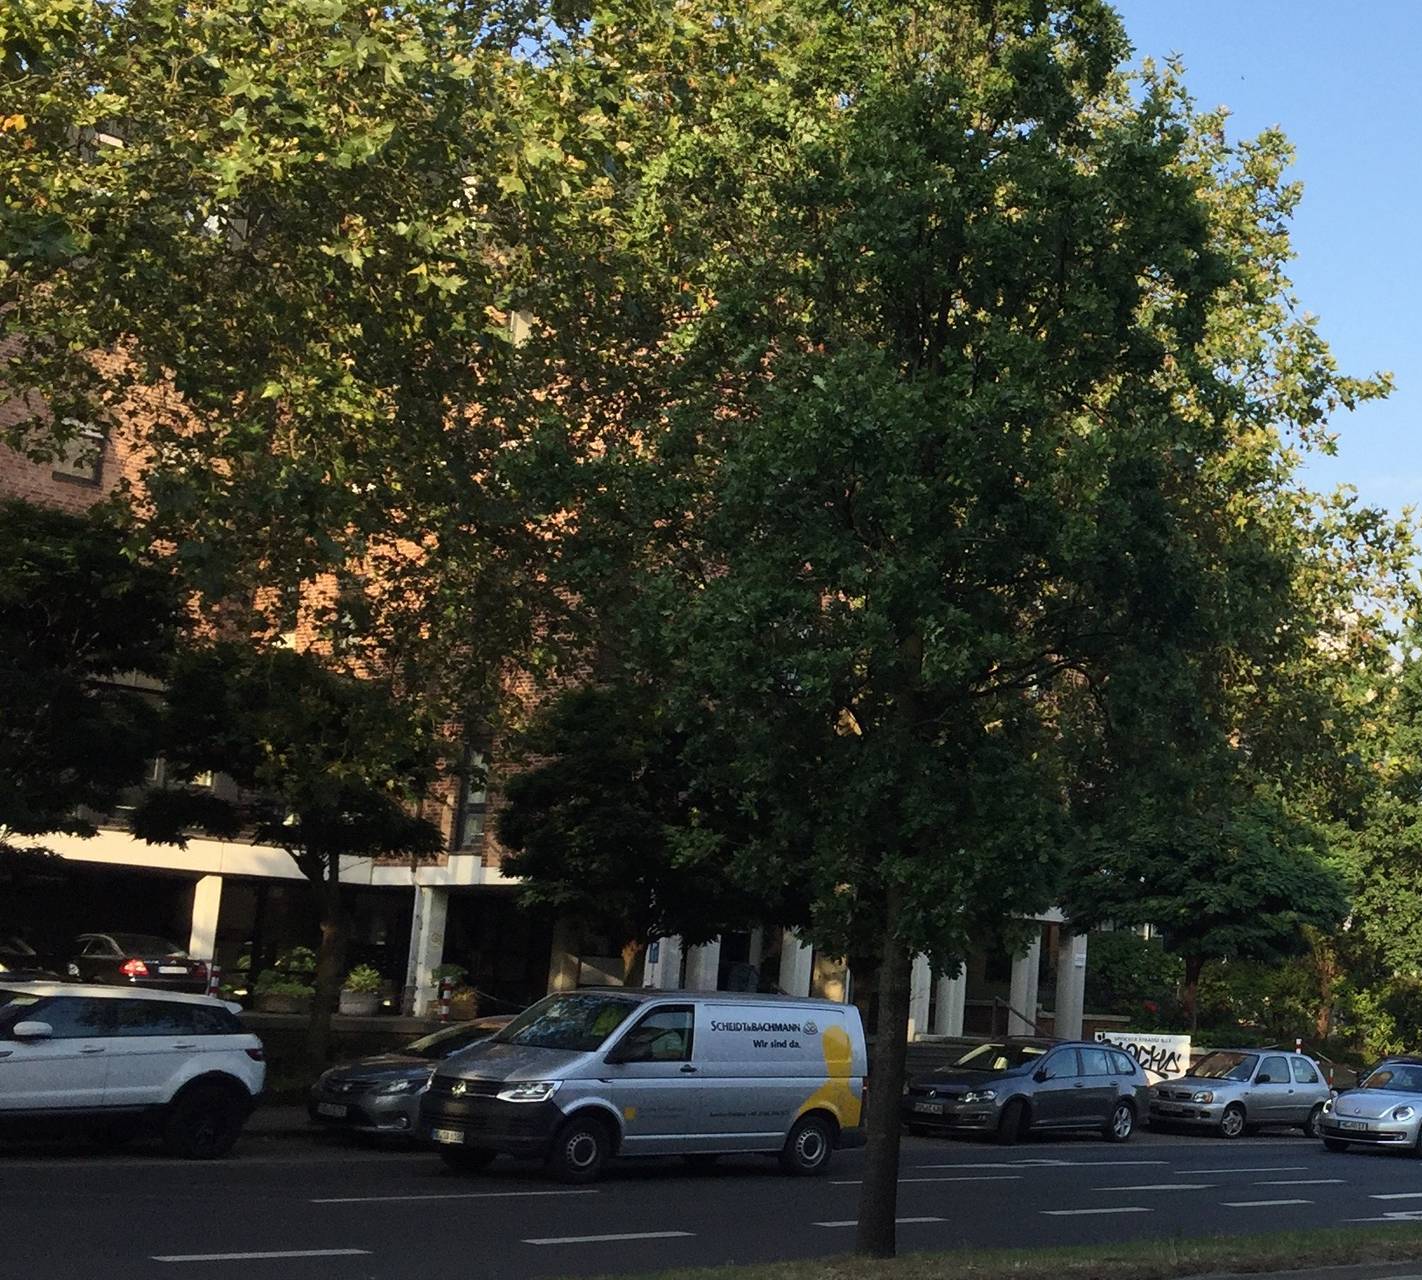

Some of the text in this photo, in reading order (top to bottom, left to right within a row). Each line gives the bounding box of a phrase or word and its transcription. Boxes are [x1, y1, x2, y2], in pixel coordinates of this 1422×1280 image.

[753, 1040, 801, 1048] Wir sind da.
